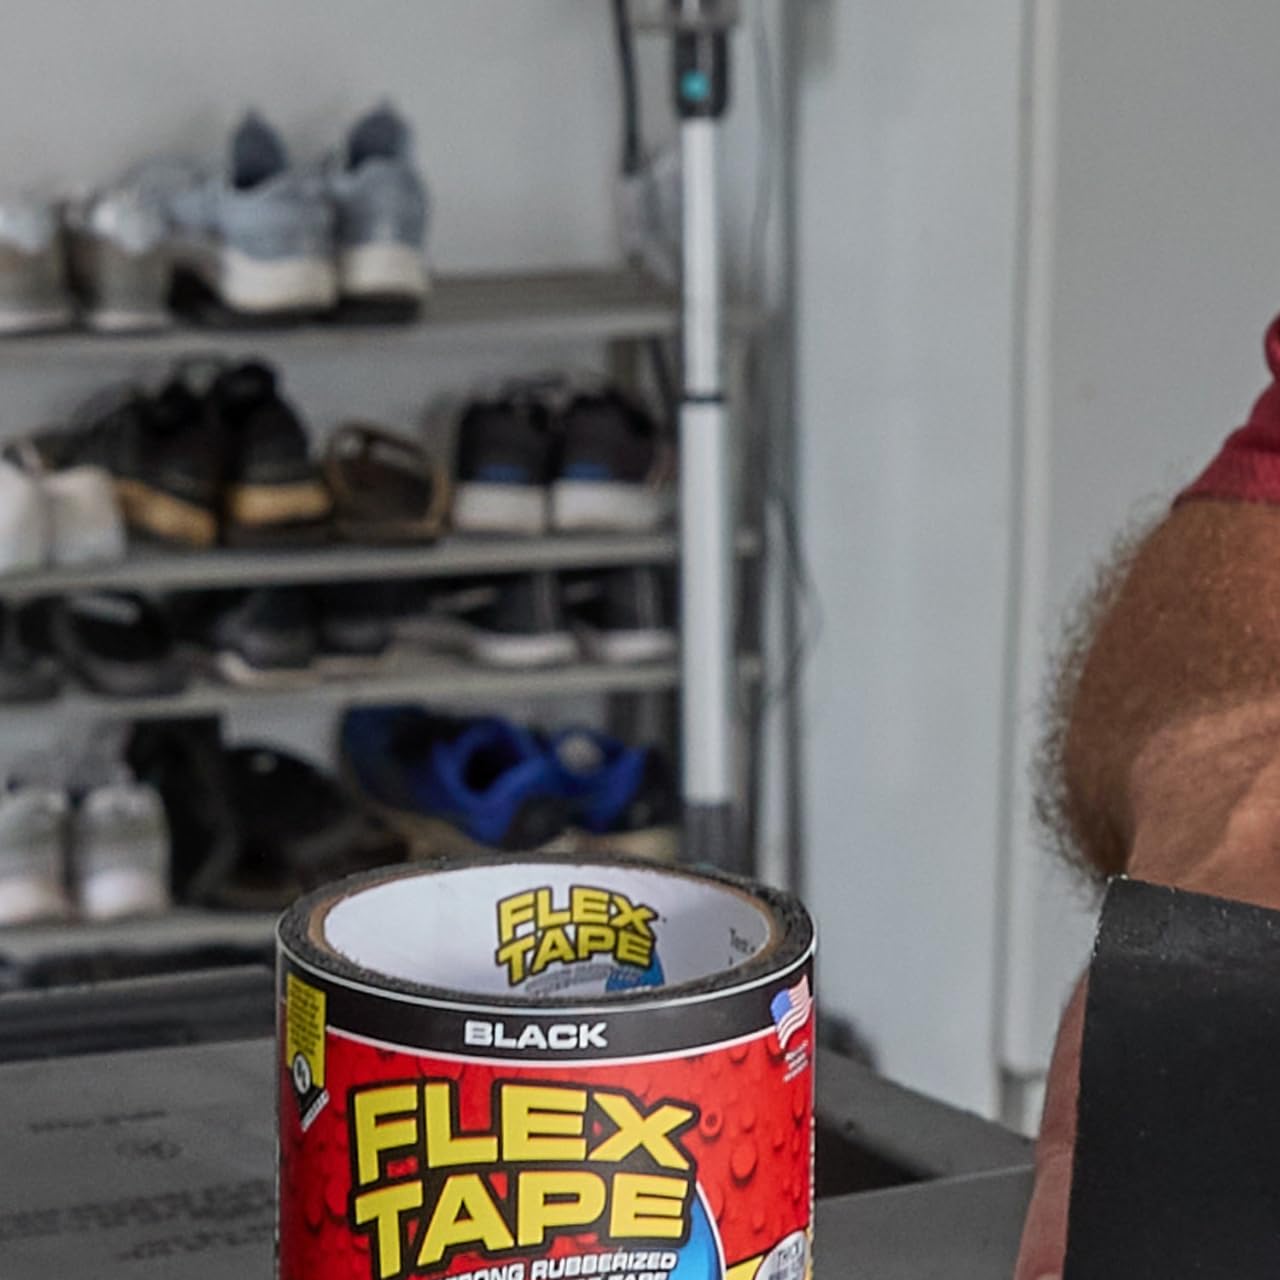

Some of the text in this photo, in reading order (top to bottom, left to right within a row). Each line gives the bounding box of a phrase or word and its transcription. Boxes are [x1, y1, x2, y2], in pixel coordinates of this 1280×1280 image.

[498, 886, 656, 945] FLEX
[497, 924, 656, 986] TAPE
[464, 1021, 607, 1049] BLACK
[353, 1081, 694, 1186] FLEX
[354, 1169, 690, 1280] TAPE
[531, 1252, 678, 1280] RUBBERIZED
